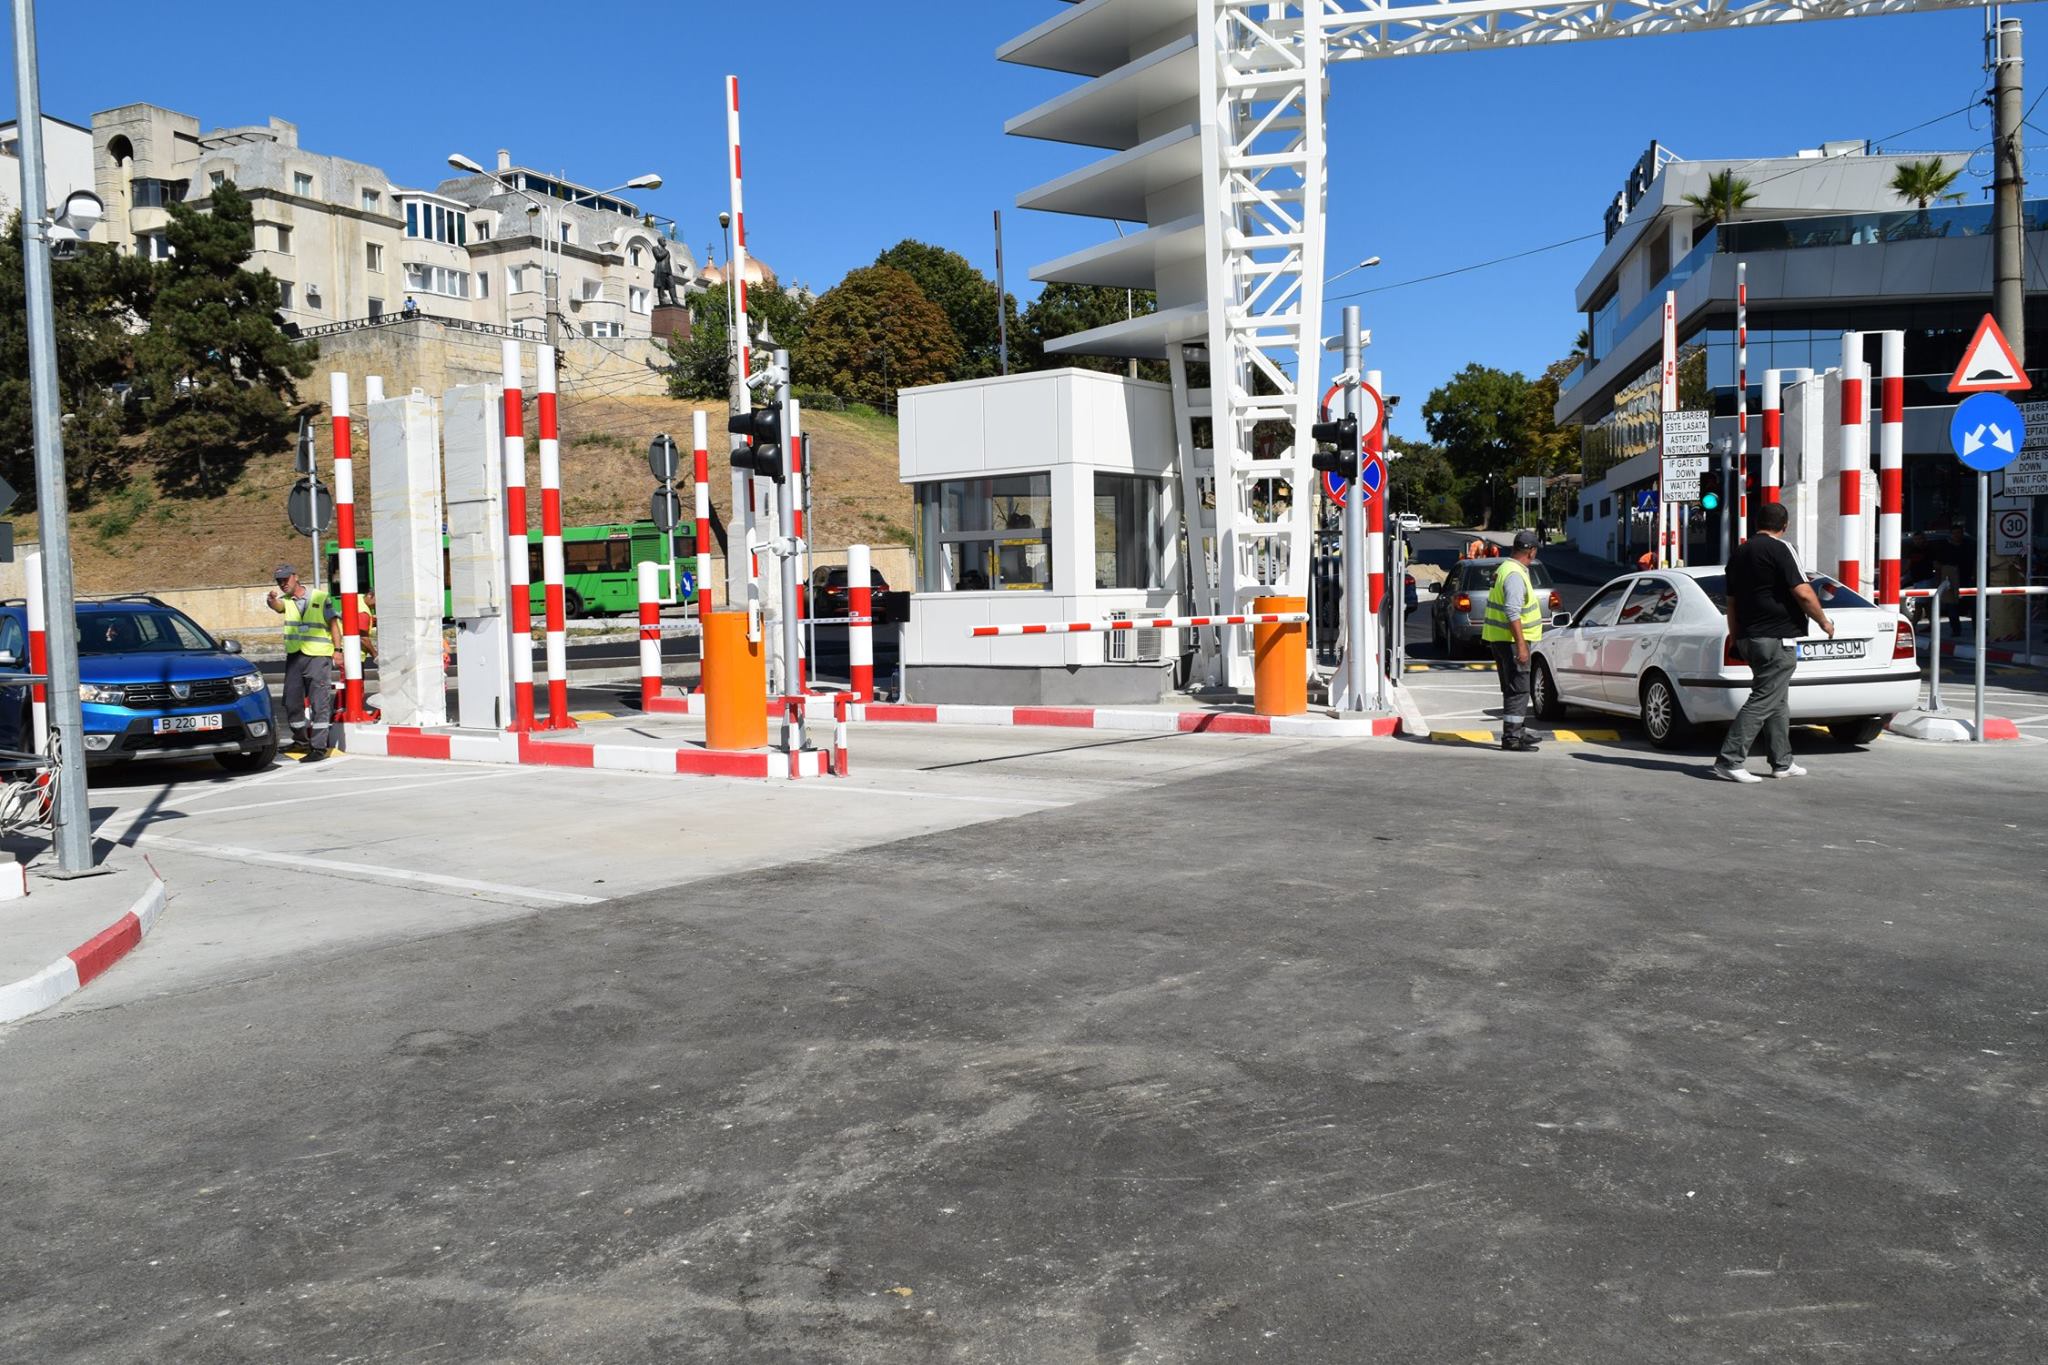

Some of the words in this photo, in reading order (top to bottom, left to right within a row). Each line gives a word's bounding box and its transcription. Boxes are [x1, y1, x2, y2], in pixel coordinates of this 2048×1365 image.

[1664, 412, 1681, 421] DACA
[1682, 411, 1708, 420] BARIERA
[1666, 422, 1681, 431] ESTE
[1683, 421, 1706, 431] LASATA
[1671, 434, 1703, 444] ASTEPTATI
[2020, 451, 2040, 461] GATE
[1669, 459, 1676, 468] IF
[1677, 459, 1695, 468] GATE
[1696, 458, 1703, 467] IS
[2019, 463, 2042, 471] DOWN
[1676, 468, 1696, 478] DOWN
[2012, 475, 2030, 484] WAIT
[2032, 474, 2048, 483] FOR
[1670, 481, 1686, 490] WAIT
[1665, 490, 1700, 500] INSTRUCTIO
[2007, 519, 2023, 532] 30
[1803, 644, 1818, 656] CT
[1823, 643, 1833, 655] 12
[1836, 641, 1861, 654] SUM
[162, 719, 171, 730] B
[176, 717, 196, 729] 220
[202, 715, 219, 727] TIS
